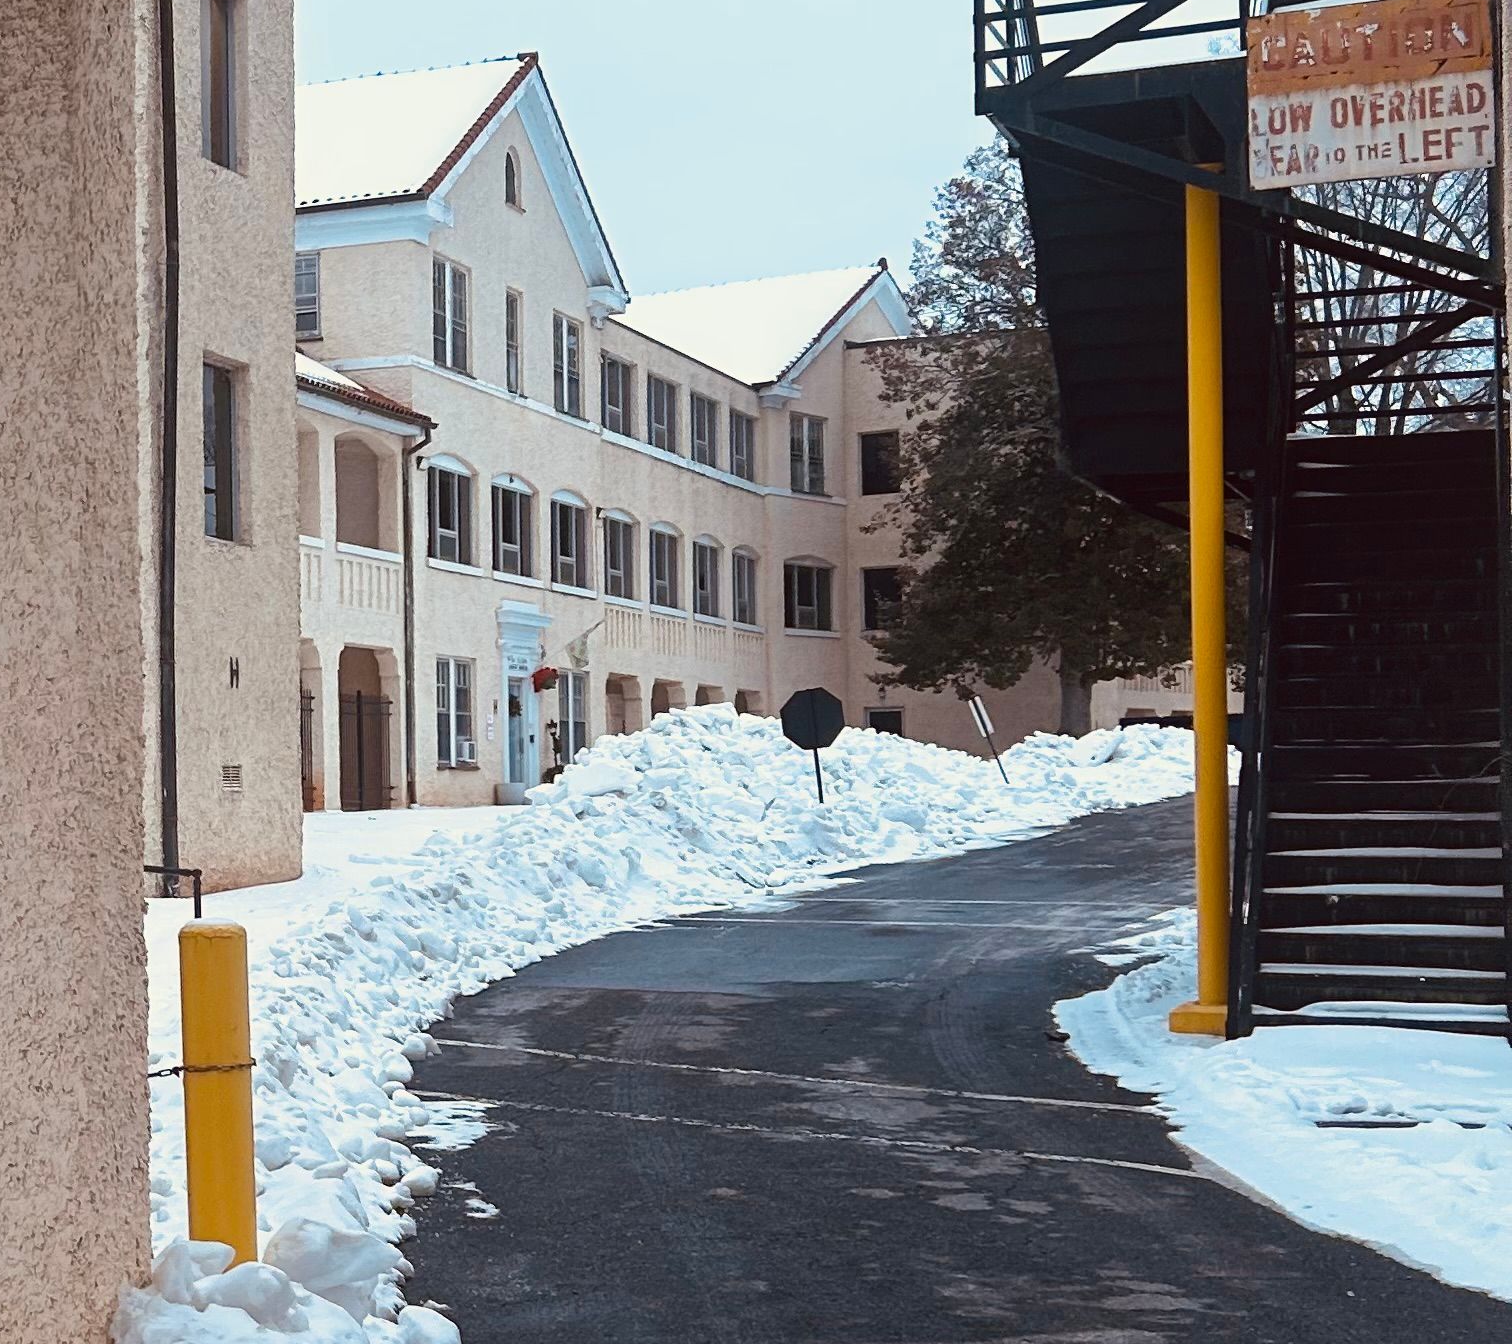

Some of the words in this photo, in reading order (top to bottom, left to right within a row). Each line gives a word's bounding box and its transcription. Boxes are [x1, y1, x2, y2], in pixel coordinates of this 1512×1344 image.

[1261, 13, 1473, 71] CAUTION
[1251, 102, 1312, 135] LOW
[1253, 142, 1319, 177] EAR
[1356, 141, 1392, 161] THE
[1399, 125, 1489, 164] LEFT
